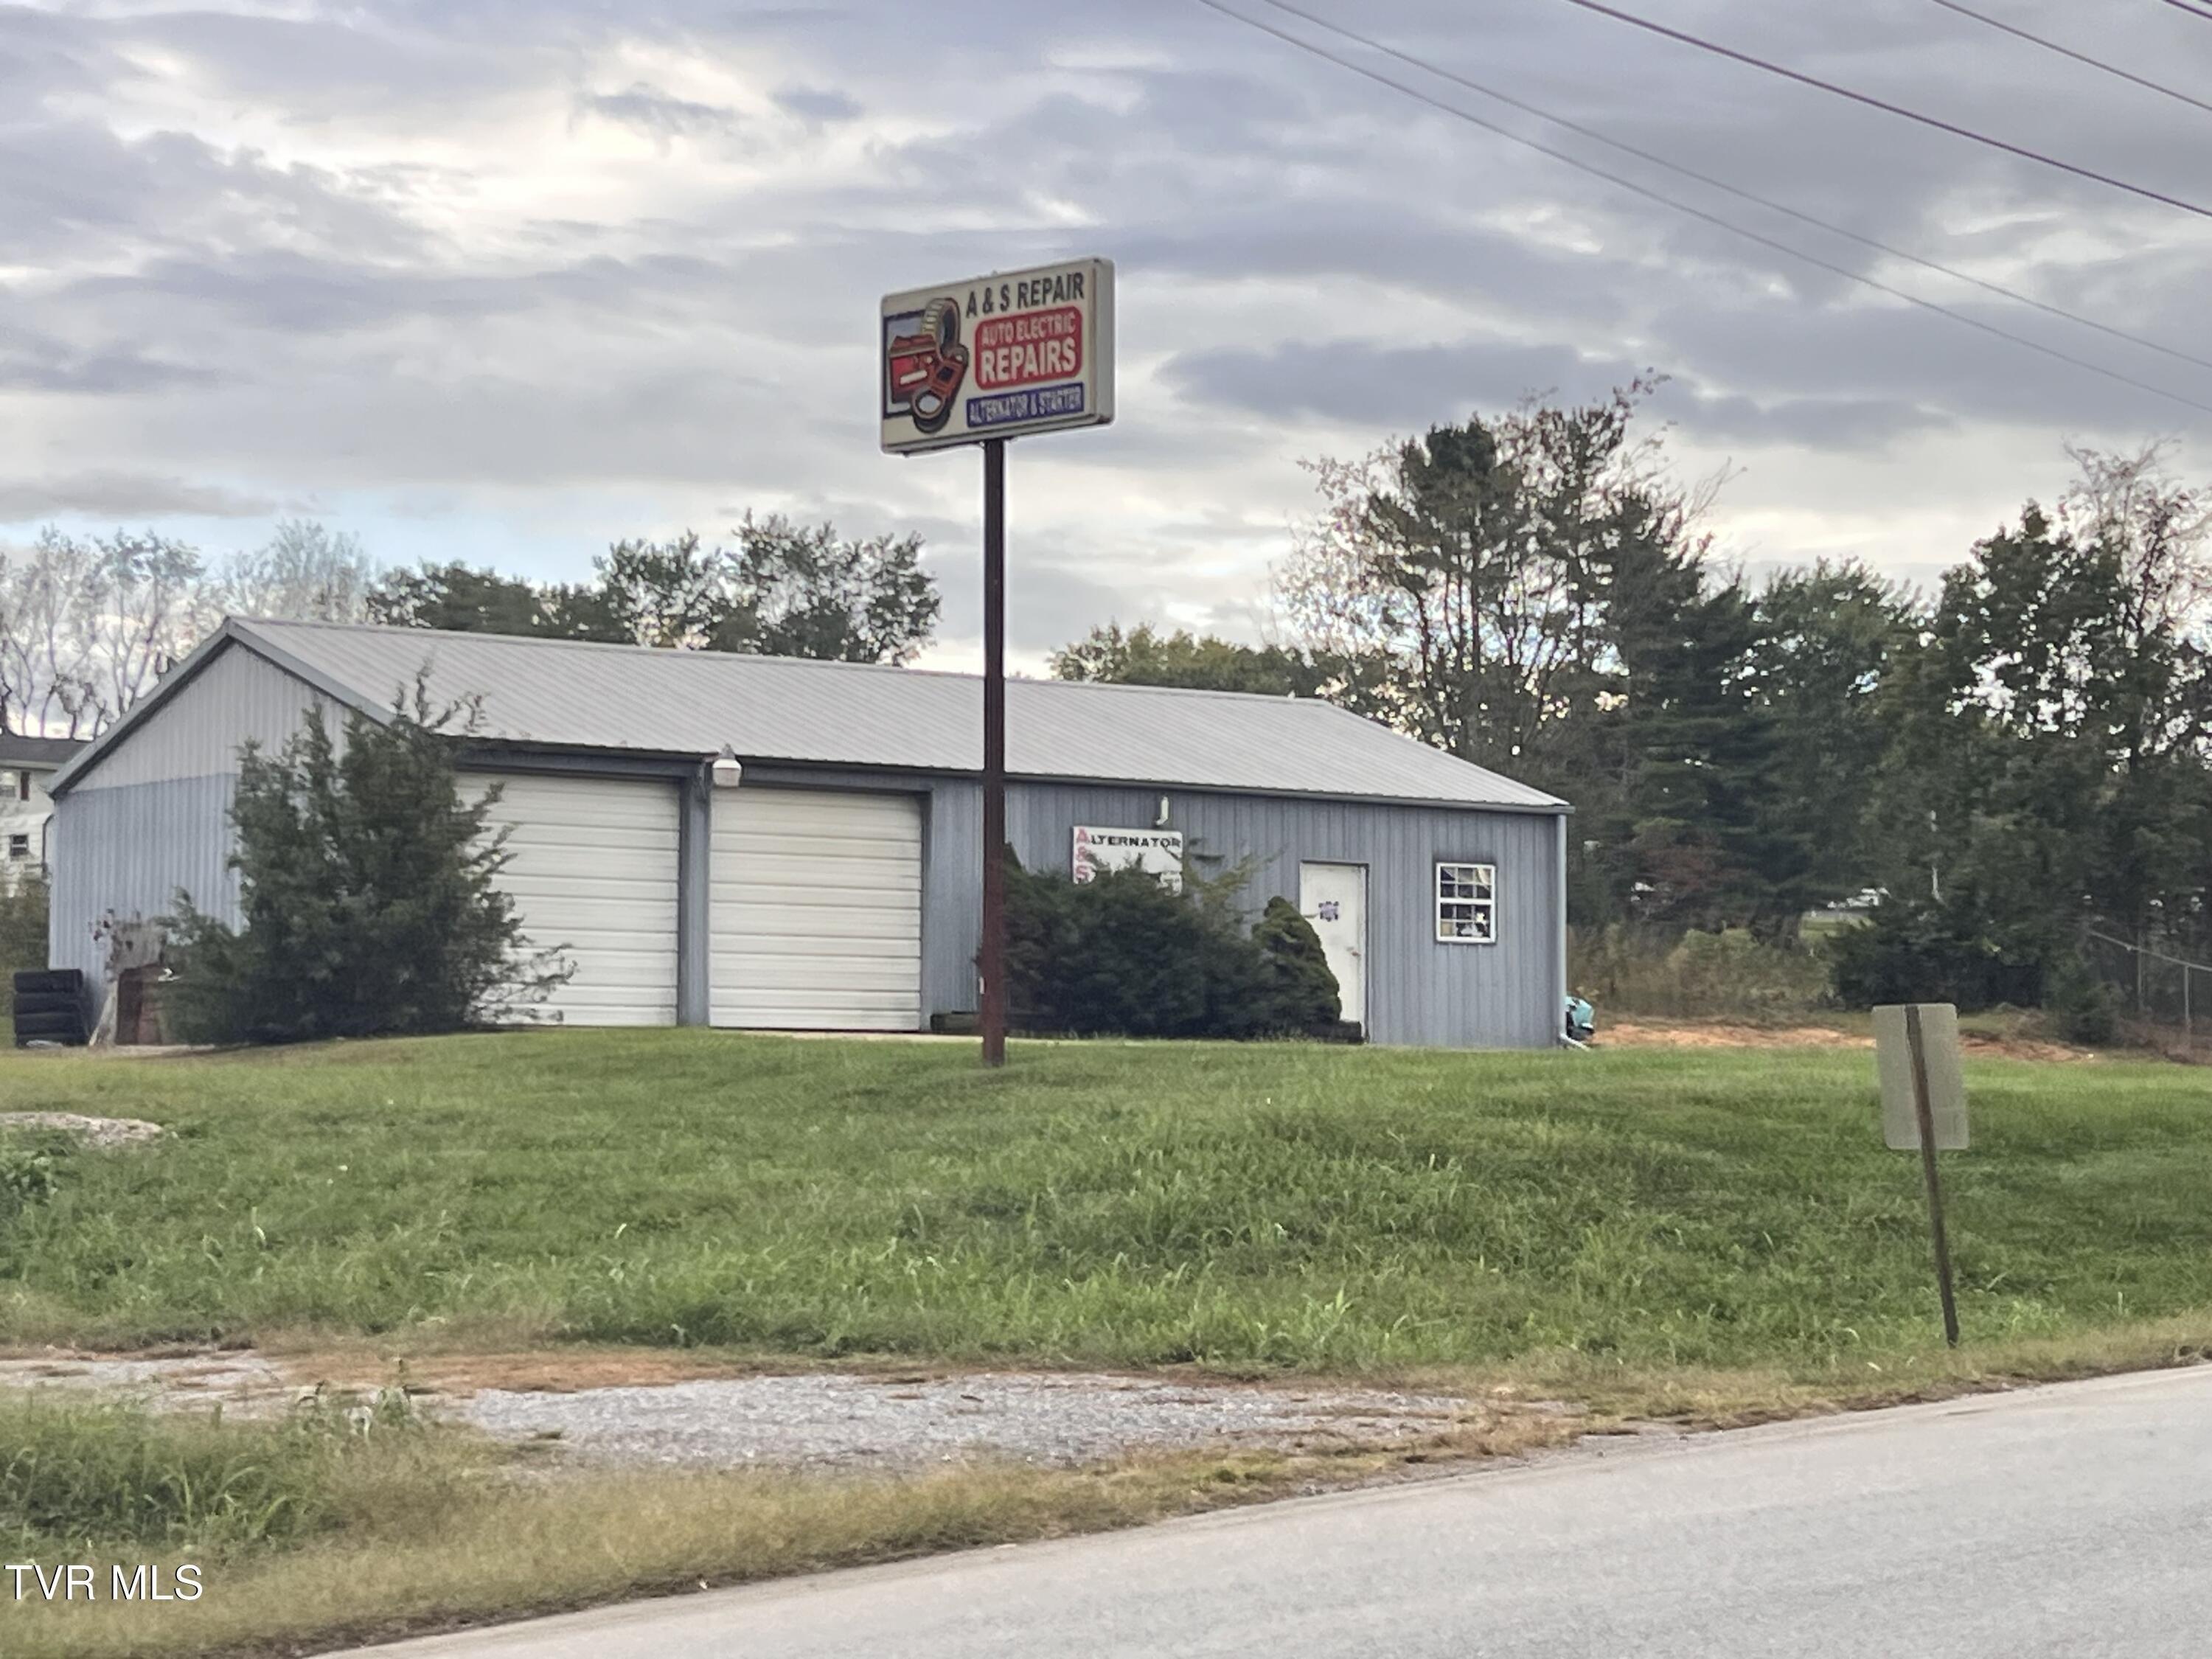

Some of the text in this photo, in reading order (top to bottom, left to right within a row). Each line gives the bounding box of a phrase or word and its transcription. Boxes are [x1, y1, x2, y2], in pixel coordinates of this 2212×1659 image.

[965, 271, 1085, 319] A & S REPAIR
[981, 311, 1077, 347] AUTO ELECTRIC
[981, 336, 1077, 383] REPAIRS
